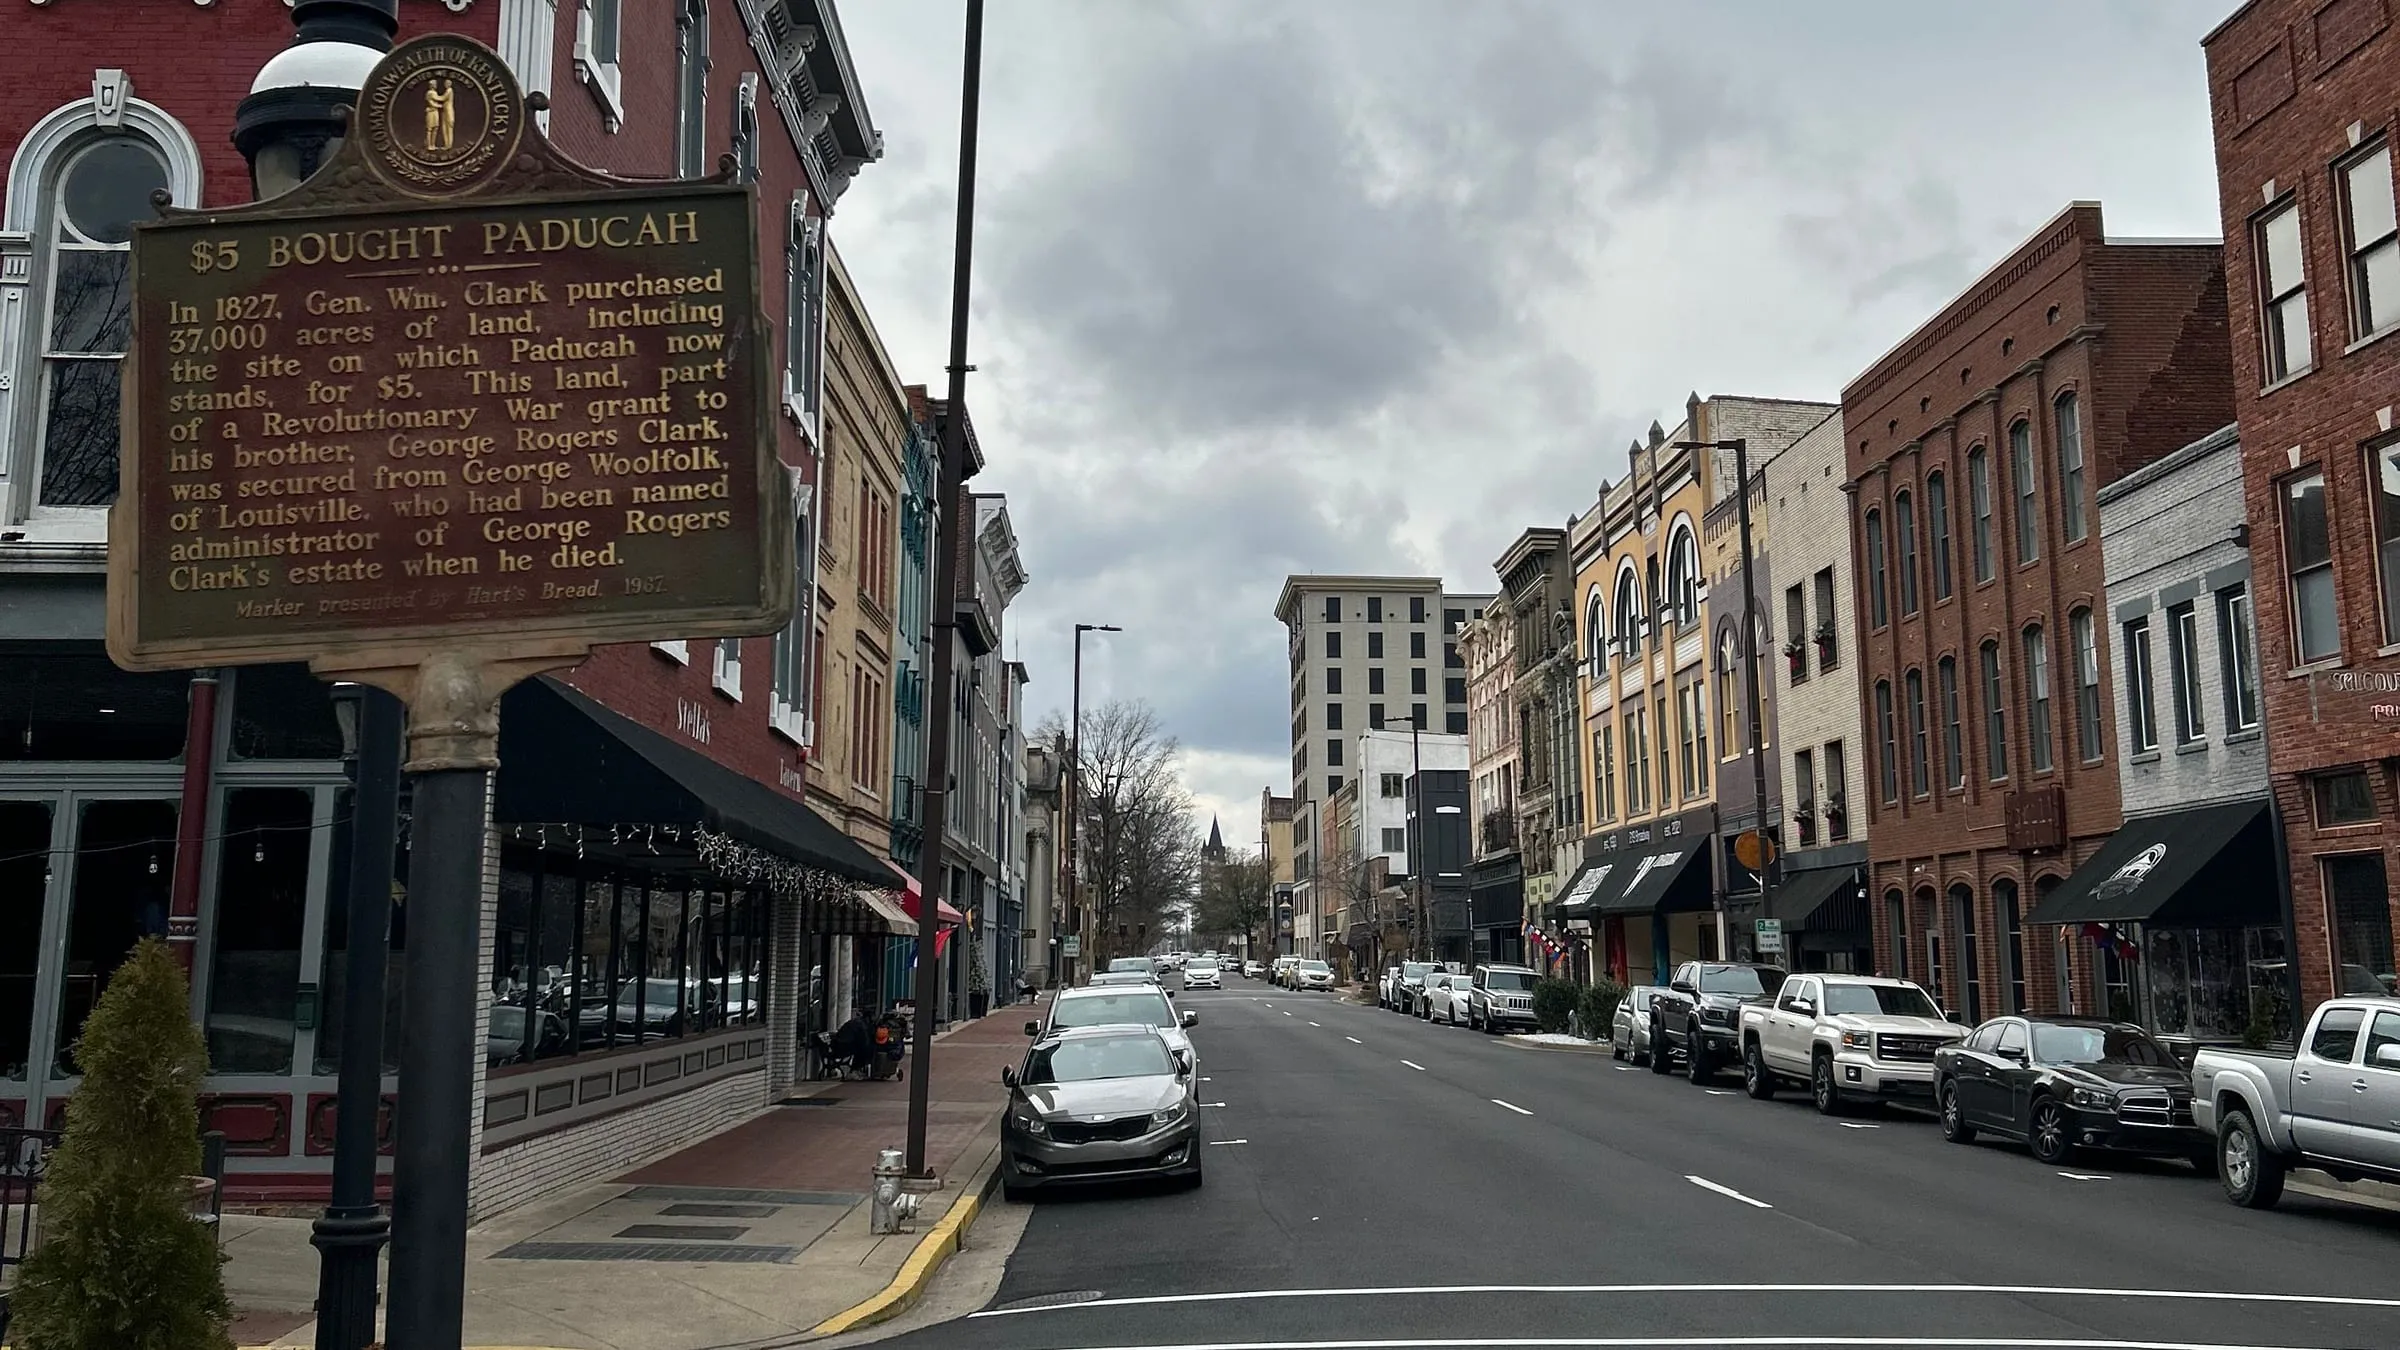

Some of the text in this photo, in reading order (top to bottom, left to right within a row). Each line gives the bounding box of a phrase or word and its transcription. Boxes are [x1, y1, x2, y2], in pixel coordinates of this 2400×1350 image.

[369, 47, 511, 152] COMMONWEALTH OF KENTUCKY
[189, 211, 700, 275] $5 BOUGHT PADUCAH
[169, 268, 724, 325] In 1827, Gen. Wm. Clark purchased
[169, 301, 724, 355] 37,000 acres of land, including
[170, 333, 726, 384] the site on which Paducah now
[170, 357, 728, 413] stands, for $5. This land, part
[169, 388, 729, 442] of a Revolutionary War grant to
[169, 416, 729, 473] his brother, George Rogers Clark,
[170, 446, 730, 501] was secured from George Woolfolk,
[169, 507, 203, 532] of
[392, 493, 449, 518] who
[467, 487, 523, 515] had
[540, 485, 614, 510] been
[632, 474, 730, 504] named
[169, 509, 732, 563] administrator of George Rogers
[169, 541, 626, 592] Clark's estate when he died.
[236, 597, 305, 620] Marker
[318, 589, 418, 617] presented
[466, 582, 527, 606] Hart's
